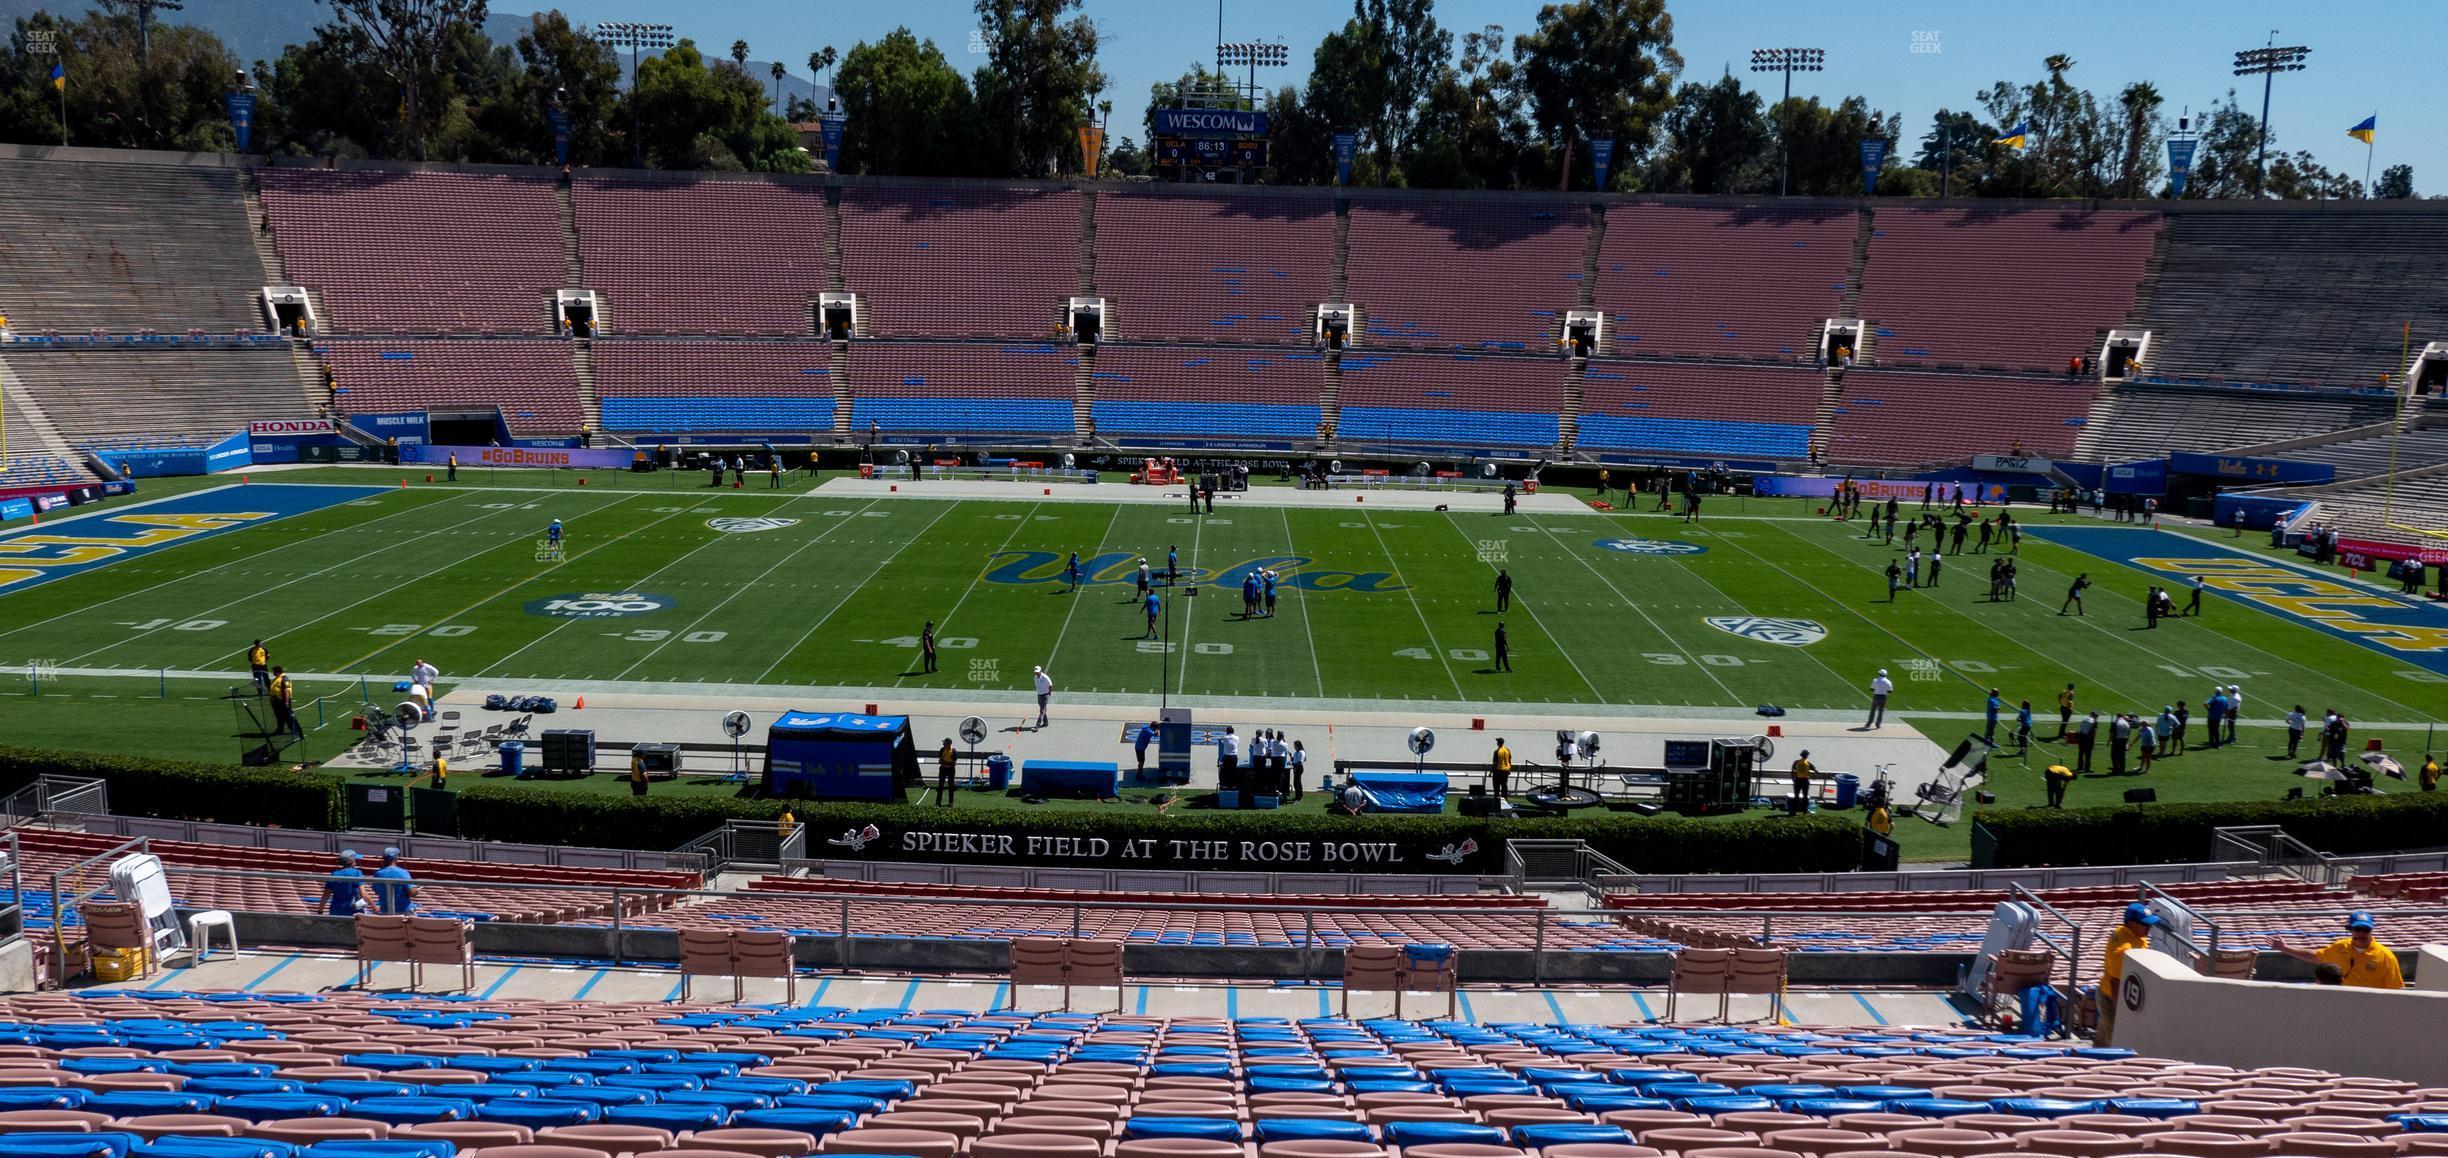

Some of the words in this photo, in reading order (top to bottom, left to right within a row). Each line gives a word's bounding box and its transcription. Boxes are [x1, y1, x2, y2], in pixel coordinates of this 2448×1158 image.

[1168, 114, 1236, 129] WESCOM
[1166, 140, 1187, 148] UCLA
[1198, 142, 1225, 151] 86:13
[1171, 149, 1178, 157] 0
[1245, 151, 1252, 159] 0
[1205, 172, 1216, 180] 42
[252, 421, 331, 432] HONDA
[377, 417, 405, 425] MUSCLE
[406, 416, 424, 424] MILK
[1193, 459, 1204, 467] AT
[2344, 552, 2366, 567] TCL
[982, 551, 1419, 592] Ucla
[544, 600, 661, 612] 100
[2128, 557, 2448, 652] UCLA
[130, 618, 229, 631] 10
[367, 624, 479, 637] 20
[624, 629, 729, 643] 30
[881, 636, 980, 649] 40
[1134, 641, 1233, 655] 50
[1392, 647, 1490, 661] 40
[1640, 652, 1745, 667] 30
[2155, 664, 2252, 679] 10
[902, 832, 1016, 855] SPIEKER
[1026, 836, 1110, 857] FIELD
[1121, 839, 1157, 859] AT
[1169, 840, 1229, 860] THE
[1240, 841, 1311, 862] ROSE
[1322, 842, 1403, 862] BOWL
[2127, 981, 2140, 1006] 19
